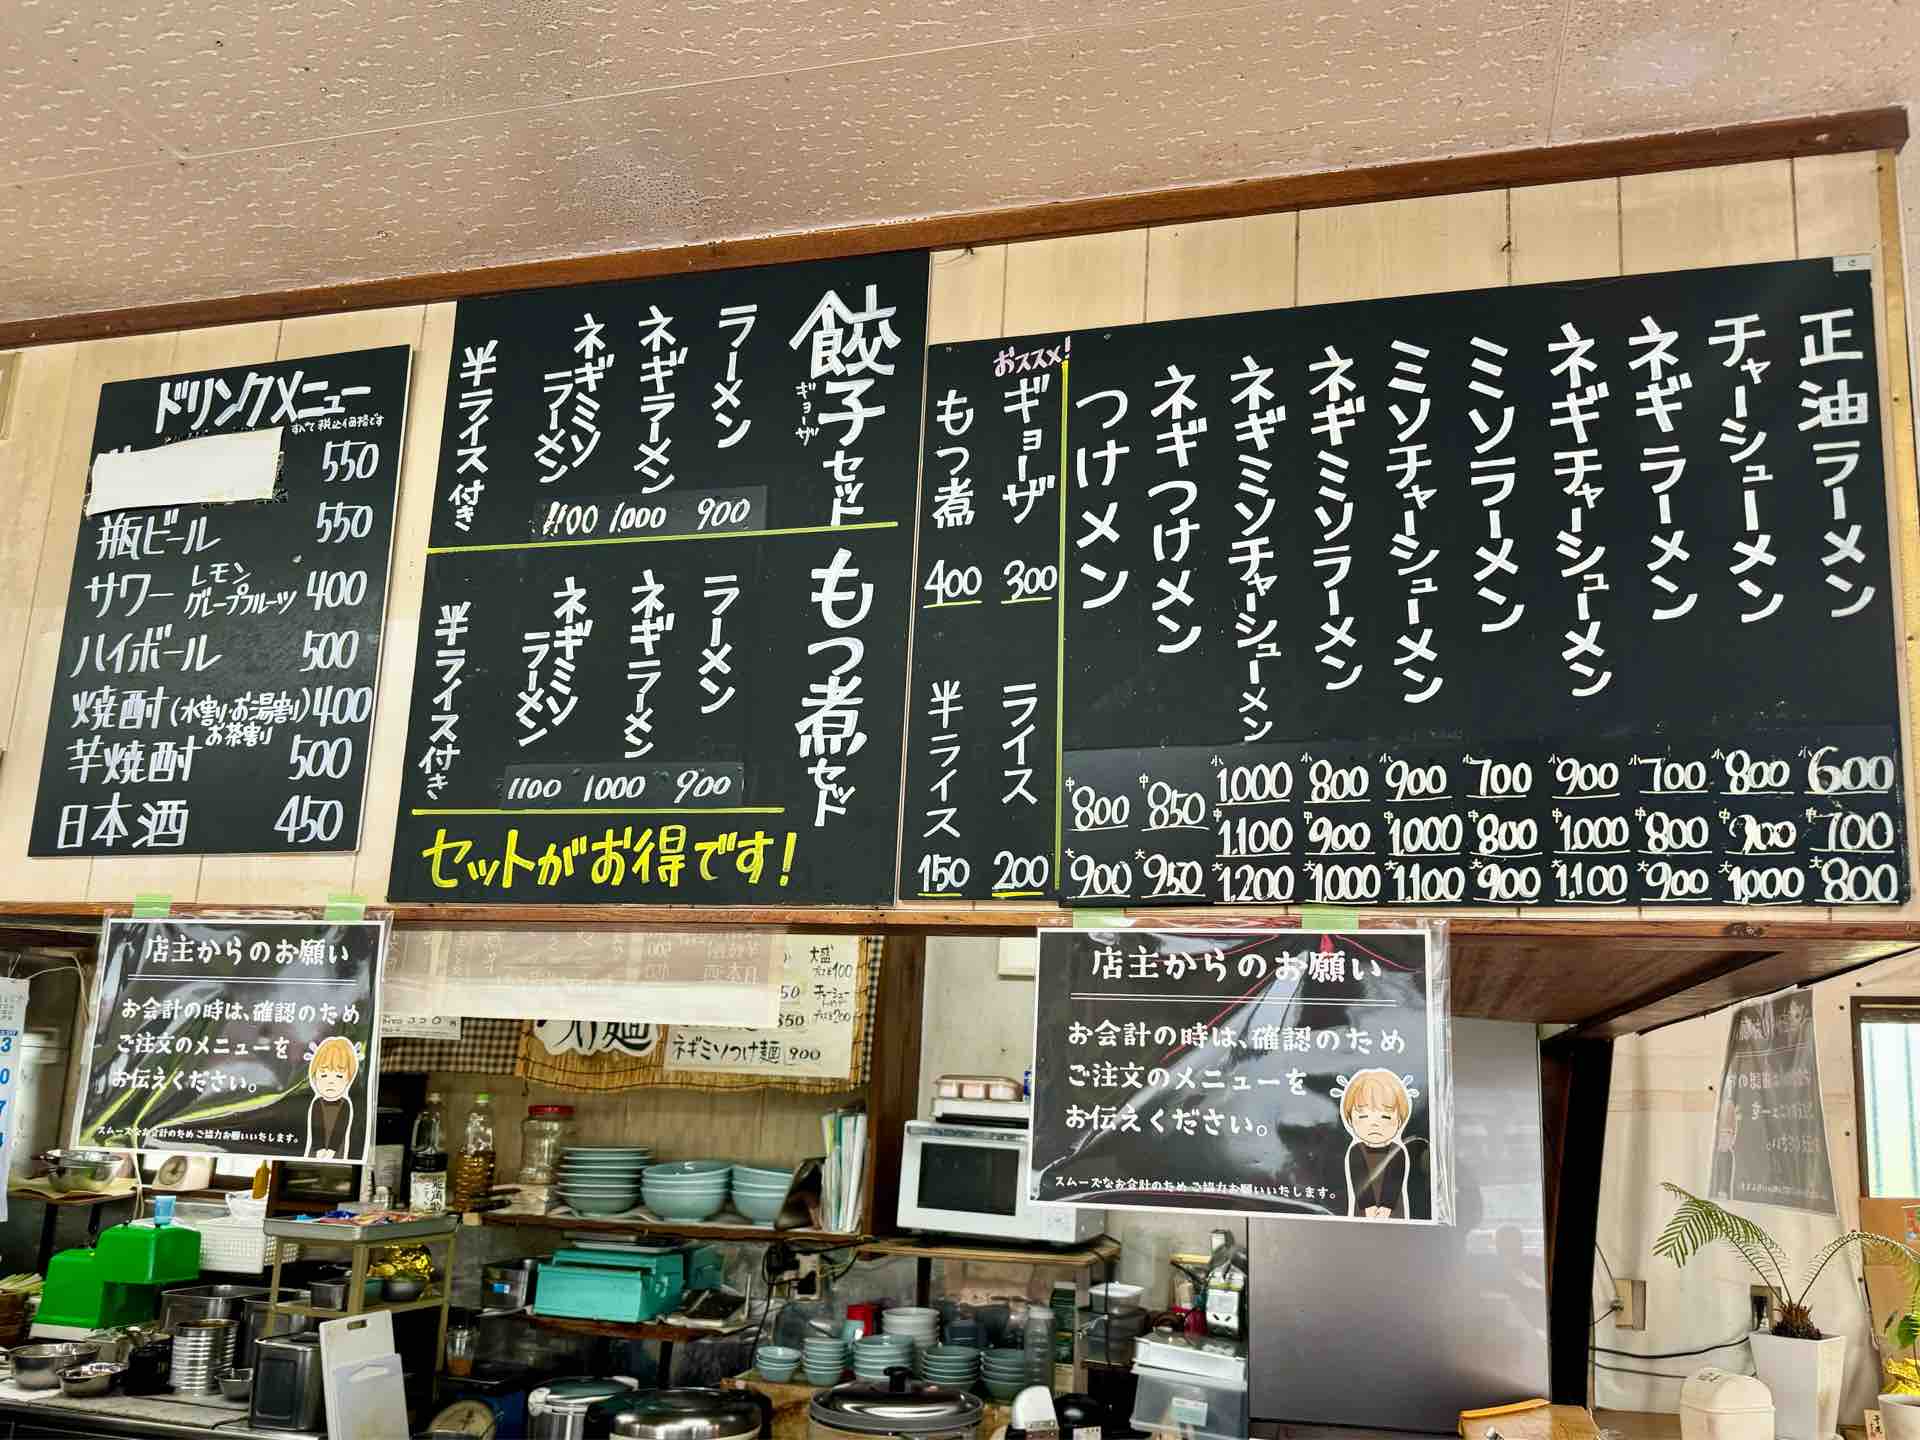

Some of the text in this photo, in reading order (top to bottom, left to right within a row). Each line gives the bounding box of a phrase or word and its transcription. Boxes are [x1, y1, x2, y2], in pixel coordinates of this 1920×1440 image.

[155, 370, 372, 434] ドリンクメニュー
[533, 371, 569, 484] ラーメン
[570, 313, 615, 468] ネギミソ
[634, 306, 688, 494] ネギラーメン
[712, 304, 758, 448] ラーメン
[789, 284, 901, 526] 餃子セット
[796, 382, 820, 445] ギョーザ
[323, 440, 380, 482] 550
[448, 339, 498, 532] 半ライス付き
[932, 389, 975, 529] もつ煮
[1002, 374, 1056, 525] ギョーザ
[1468, 336, 1525, 632] ミソラーメン
[1628, 315, 1698, 620] ネギラーメン
[1708, 313, 1785, 623] チャーシューメン
[1797, 307, 1875, 618] 正油ラーメン
[95, 502, 374, 561] 瓶ビール 550
[697, 498, 751, 530] 900
[1076, 389, 1130, 609] つけメン
[1147, 364, 1208, 654] ネギつけメン
[1228, 355, 1287, 742] ネギミソチャーシューメン
[1308, 345, 1365, 690] ネギミソラーメン
[1385, 339, 1444, 704] ミソチャーシューメン
[1547, 322, 1612, 697] ネギチャーシューメン
[84, 570, 367, 618] サワー 400
[184, 583, 298, 620] グレープフルーツ
[192, 561, 252, 588] レモン
[924, 559, 1058, 606] 400 300
[70, 624, 360, 679] ハイボール 500
[417, 600, 472, 801] 半ライス付き
[514, 631, 553, 747] ラーメン
[547, 576, 594, 727] ネギミソ
[624, 569, 675, 759] ネギラーメン
[698, 574, 740, 714] ラーメン
[795, 548, 874, 828] もつ煮セット
[66, 735, 352, 784] 芋焼酎 500
[72, 686, 170, 730] 焼酎
[312, 686, 374, 727] 400
[922, 679, 964, 838] 半ライス
[1002, 683, 1039, 805] ライス
[56, 791, 344, 849] 日本酒 450
[584, 775, 646, 802] 1000
[674, 770, 732, 804] 900
[917, 850, 1049, 892] 150 200
[146, 935, 350, 967] 店主からのお願い
[1092, 944, 1382, 984] 店主からのお願い
[117, 1033, 290, 1060] ご注文のメニューを
[120, 997, 361, 1025] お会計の時は、確認のため
[672, 1033, 821, 1064] ネギミソつけ麺 900
[1068, 1019, 1407, 1056] お会計の時は、確認のため
[111, 1069, 258, 1094] お伝えください。
[1065, 1104, 1269, 1138] お伝えください。
[1068, 1061, 1308, 1097] ご注文のメニューを
